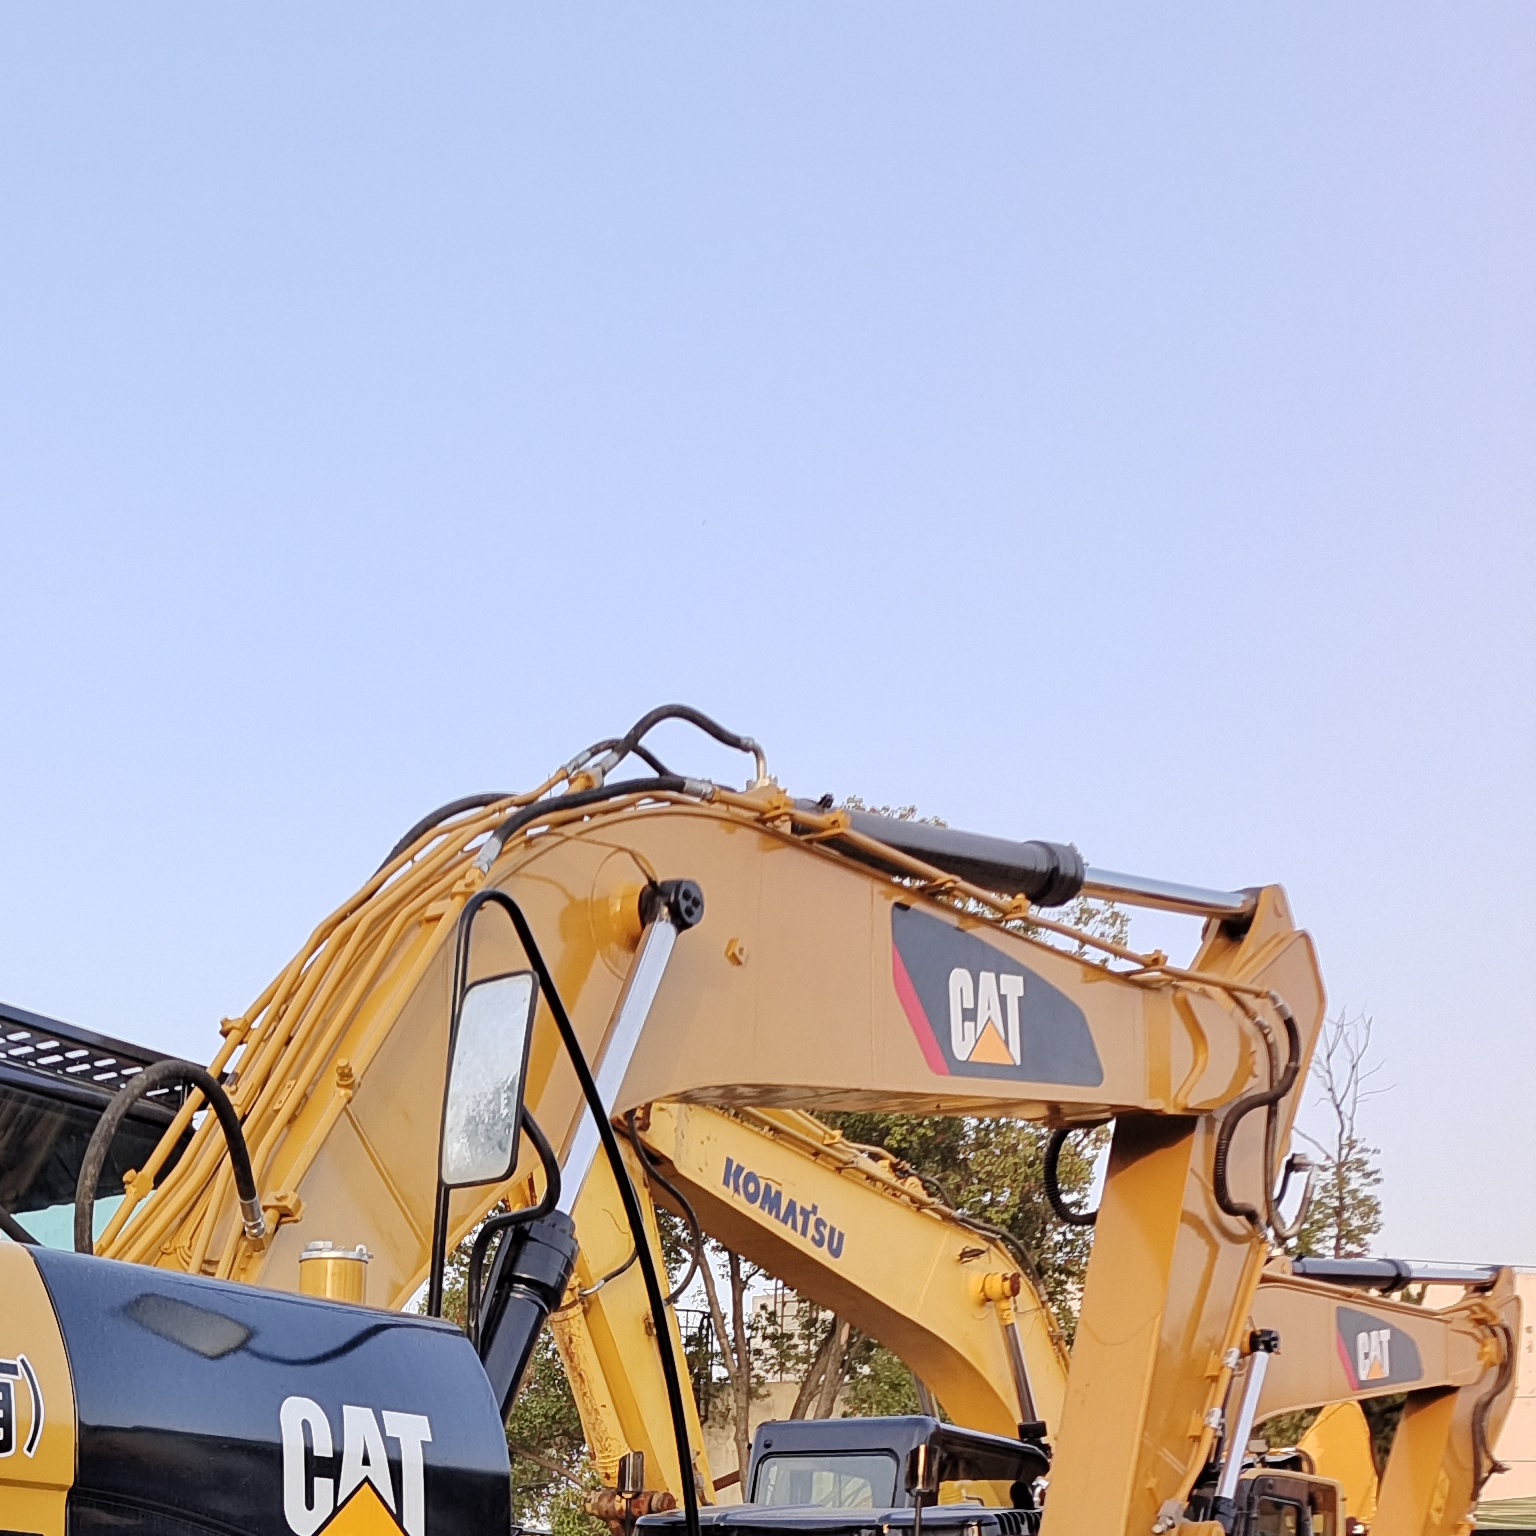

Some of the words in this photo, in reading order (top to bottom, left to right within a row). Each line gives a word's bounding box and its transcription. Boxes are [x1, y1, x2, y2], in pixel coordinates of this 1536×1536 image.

[949, 968, 1024, 1066] CAT
[722, 1156, 845, 1259] KOMATSU
[1356, 1329, 1391, 1381] CAT
